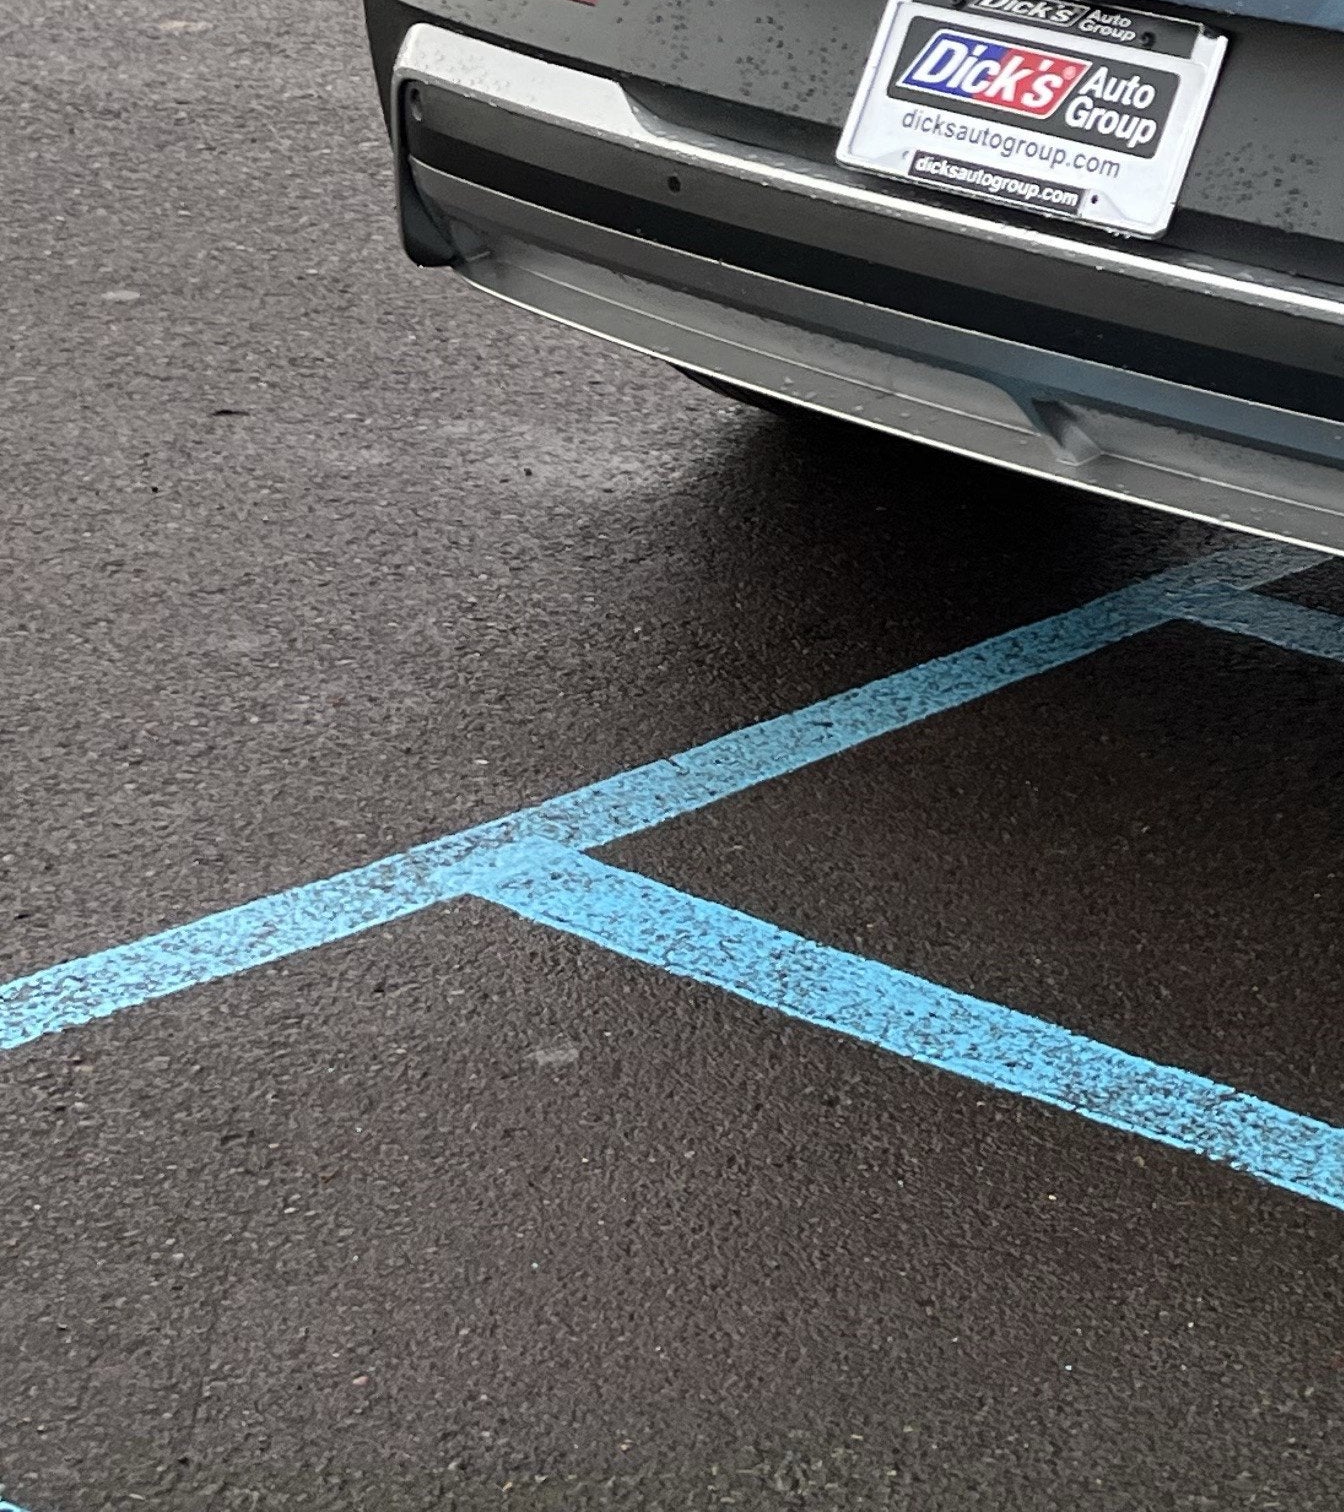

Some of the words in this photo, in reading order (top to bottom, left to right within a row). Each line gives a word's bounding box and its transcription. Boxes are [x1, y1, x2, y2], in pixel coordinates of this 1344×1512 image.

[1078, 19, 1137, 42] Group
[1086, 9, 1132, 28] Auto
[911, 37, 1064, 110] Dick's
[1078, 66, 1156, 110] Auto
[902, 109, 1122, 179] dicksautogroup.com
[1064, 95, 1158, 148] Group
[914, 154, 1079, 208] dicksautogroup.com
